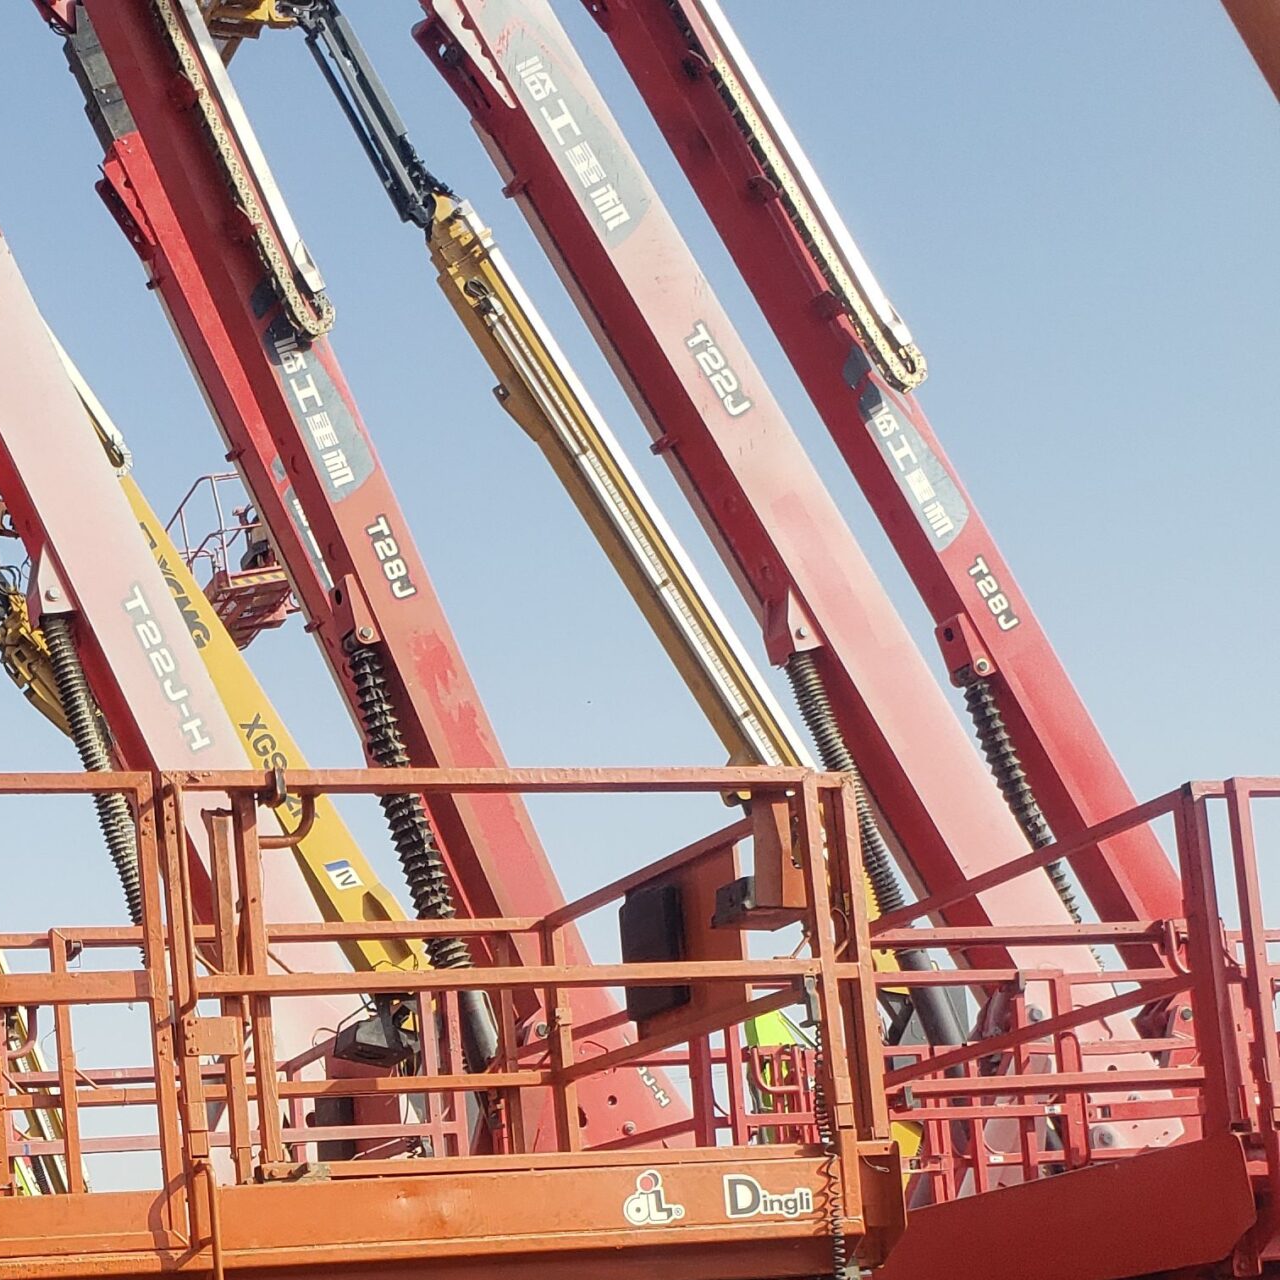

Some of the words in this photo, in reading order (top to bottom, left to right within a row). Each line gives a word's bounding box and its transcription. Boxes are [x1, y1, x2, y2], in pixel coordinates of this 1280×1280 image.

[516, 55, 631, 232] 临工重机
[273, 336, 355, 489] 临工重机
[686, 322, 752, 416] T22J
[868, 400, 954, 538] 临工重机
[366, 515, 417, 599] T28J
[968, 556, 1020, 631] T28J
[124, 585, 211, 751] T22J-H
[725, 1176, 812, 1218] Dingli
